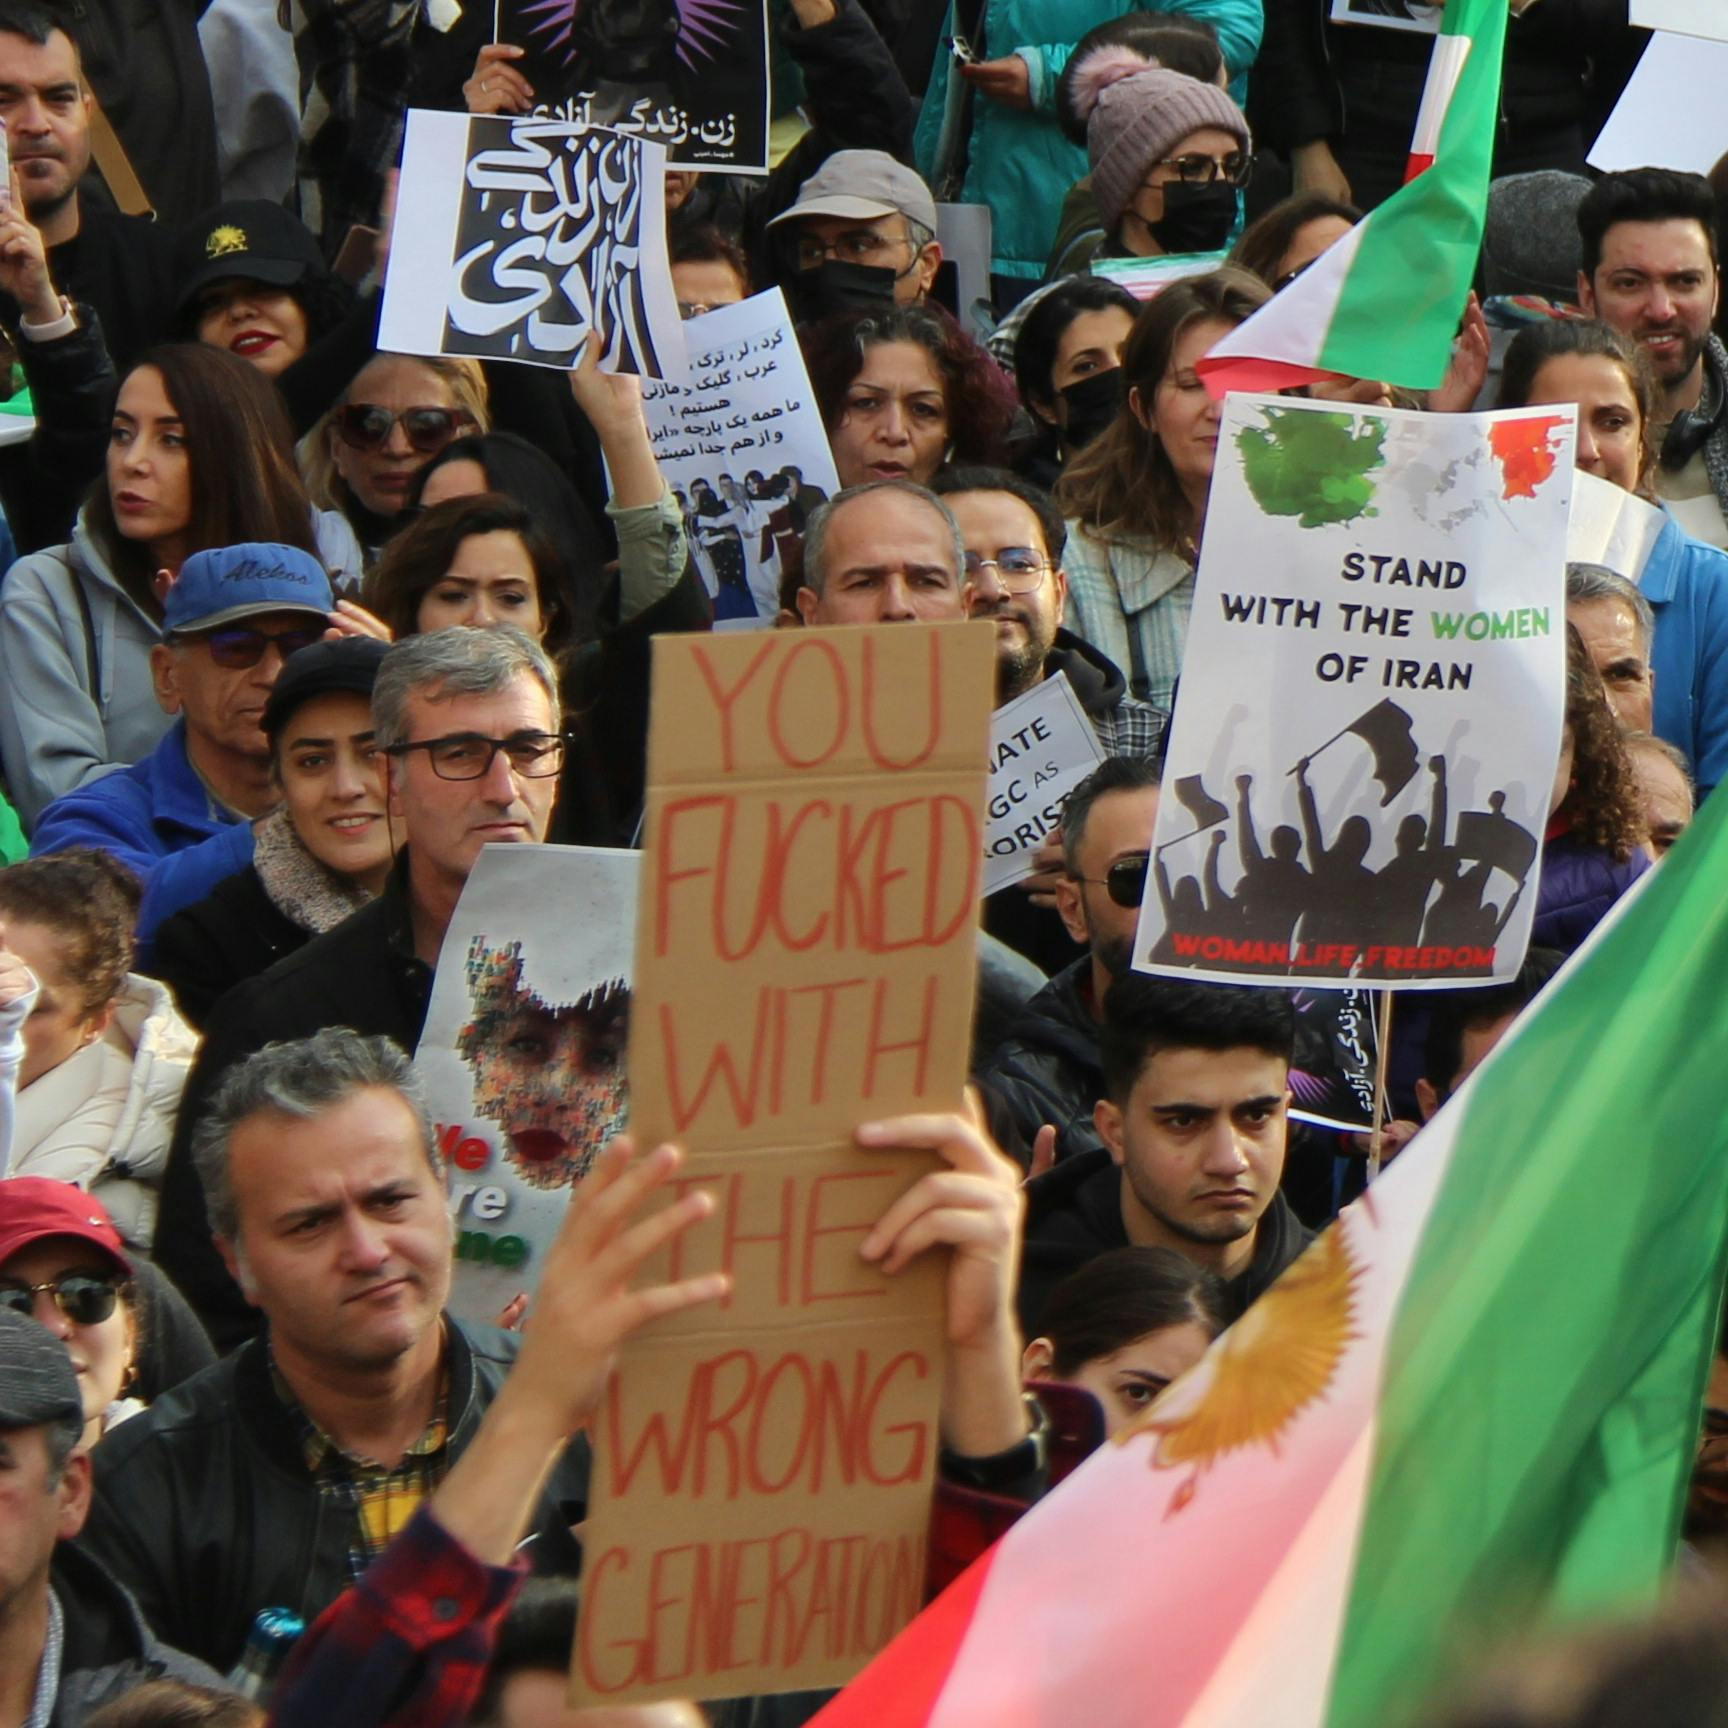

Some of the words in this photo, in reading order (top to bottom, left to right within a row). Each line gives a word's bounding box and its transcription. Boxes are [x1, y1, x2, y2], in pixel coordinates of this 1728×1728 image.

[744, 359, 778, 381] عرب
[725, 415, 748, 430] یک
[750, 407, 784, 423] همه
[729, 437, 755, 456] هم
[1341, 552, 1467, 590] STAND
[1220, 593, 1322, 629] WITH
[1338, 601, 1414, 637] THE
[1430, 607, 1551, 640] WOMEN
[1315, 651, 1368, 685] OF
[1383, 659, 1473, 691] IRAN
[688, 628, 945, 771] YOU
[1033, 760, 1060, 790] AS
[652, 795, 980, 962] FUCKED
[658, 974, 942, 1133] WITH
[662, 1172, 900, 1309] THE
[608, 1349, 930, 1499] WRONG
